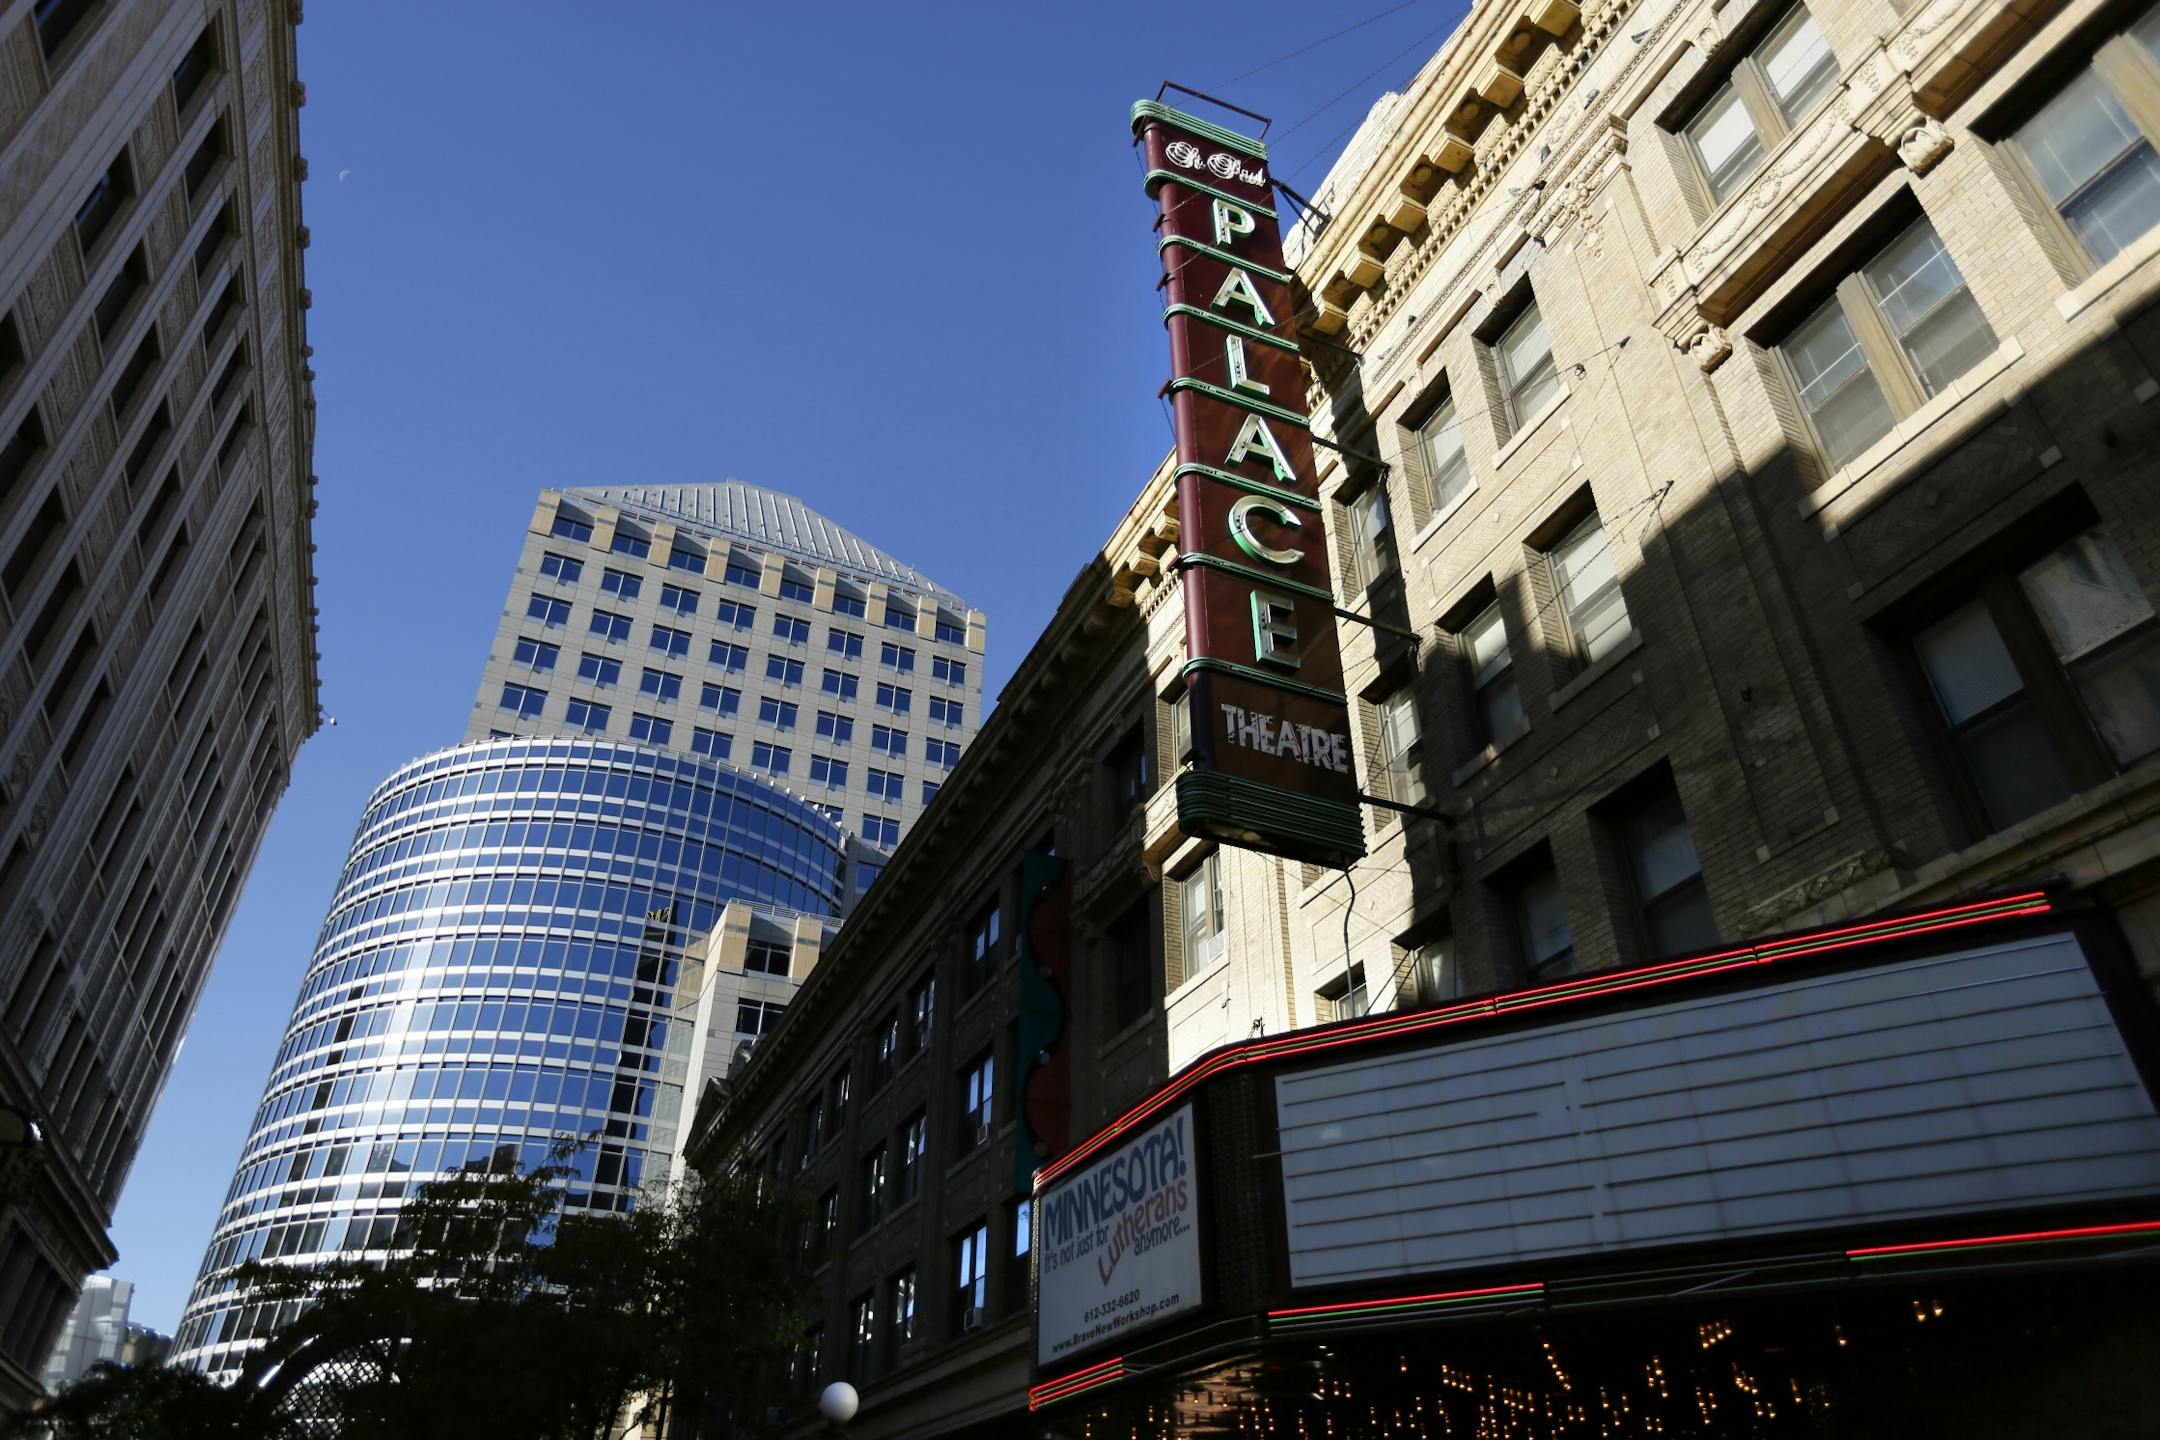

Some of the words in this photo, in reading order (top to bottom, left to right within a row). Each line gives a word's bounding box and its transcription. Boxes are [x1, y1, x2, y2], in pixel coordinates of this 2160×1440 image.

[1211, 198, 1306, 670] PALACE
[1221, 703, 1349, 774] THEATRE
[1045, 1116, 1187, 1251] MINNESOTA!
[1060, 1240, 1074, 1266] not
[1075, 1231, 1093, 1258] just
[1096, 1224, 1109, 1248] for
[1098, 1179, 1188, 1287] Lutherans
[1084, 1289, 1140, 1323] 612-332-6620
